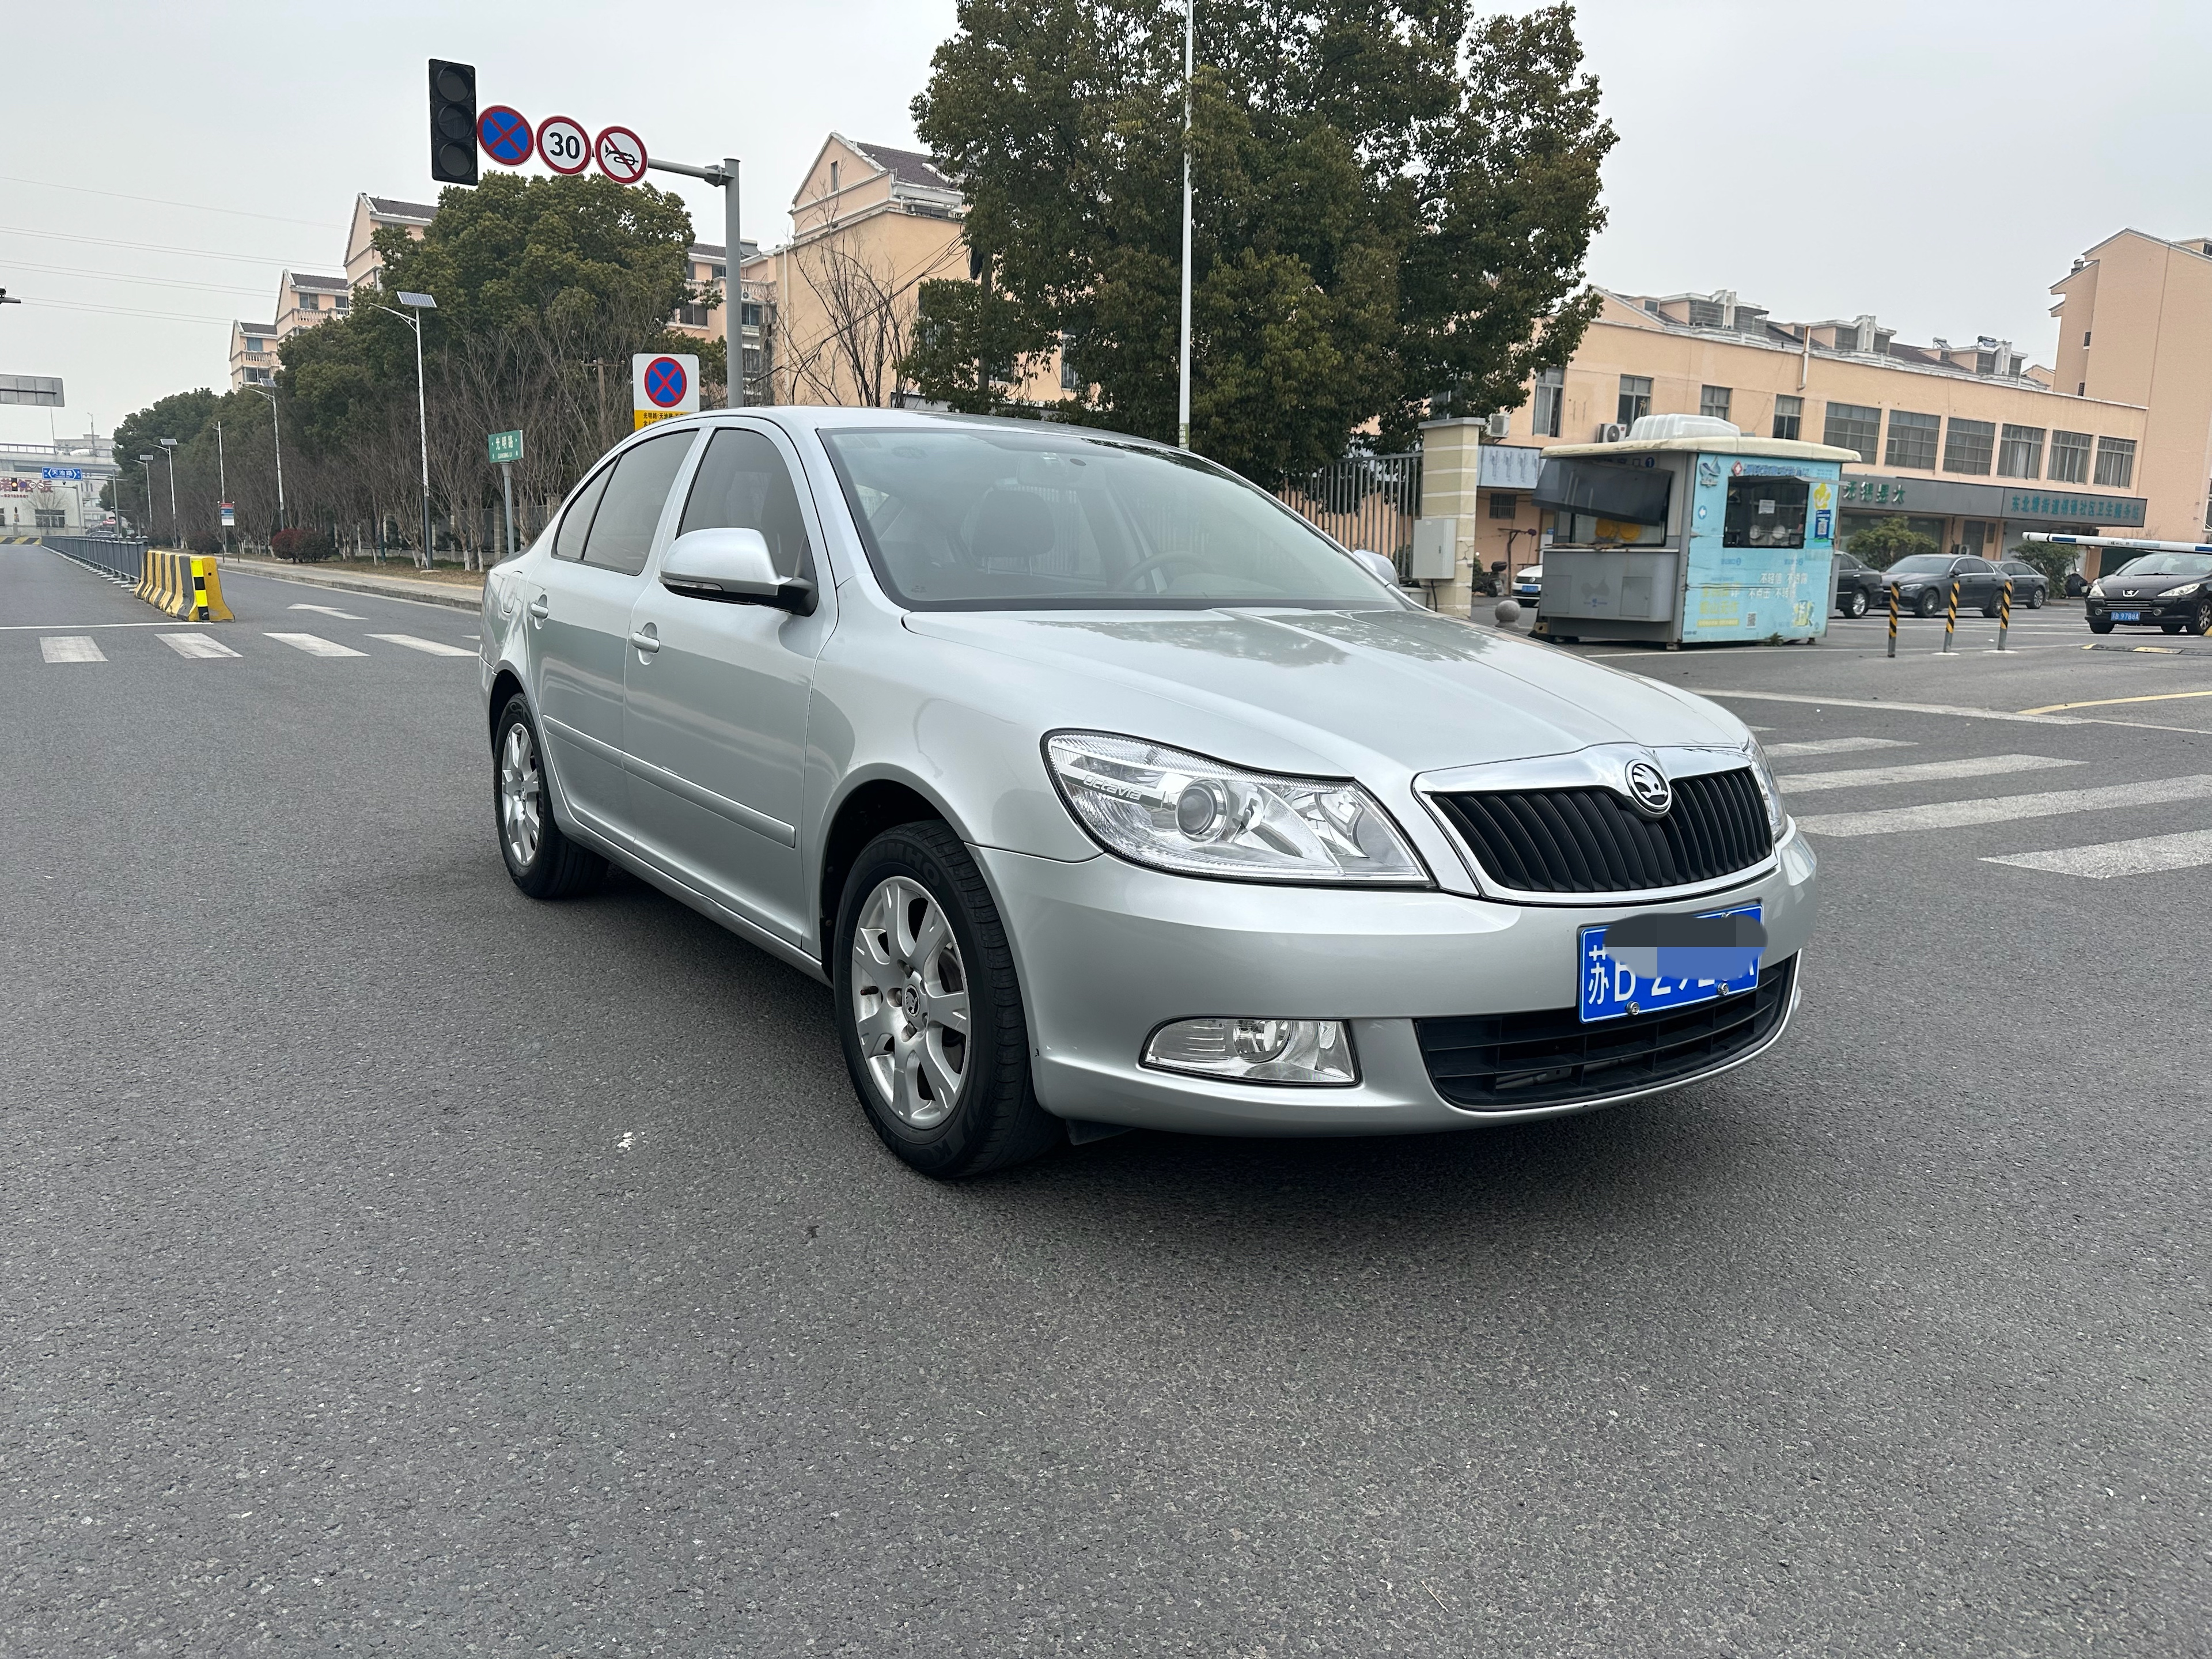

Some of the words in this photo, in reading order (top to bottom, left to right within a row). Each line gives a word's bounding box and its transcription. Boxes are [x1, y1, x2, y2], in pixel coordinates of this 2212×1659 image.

[549, 132, 580, 160] 30
[495, 435, 513, 450] 光明路
